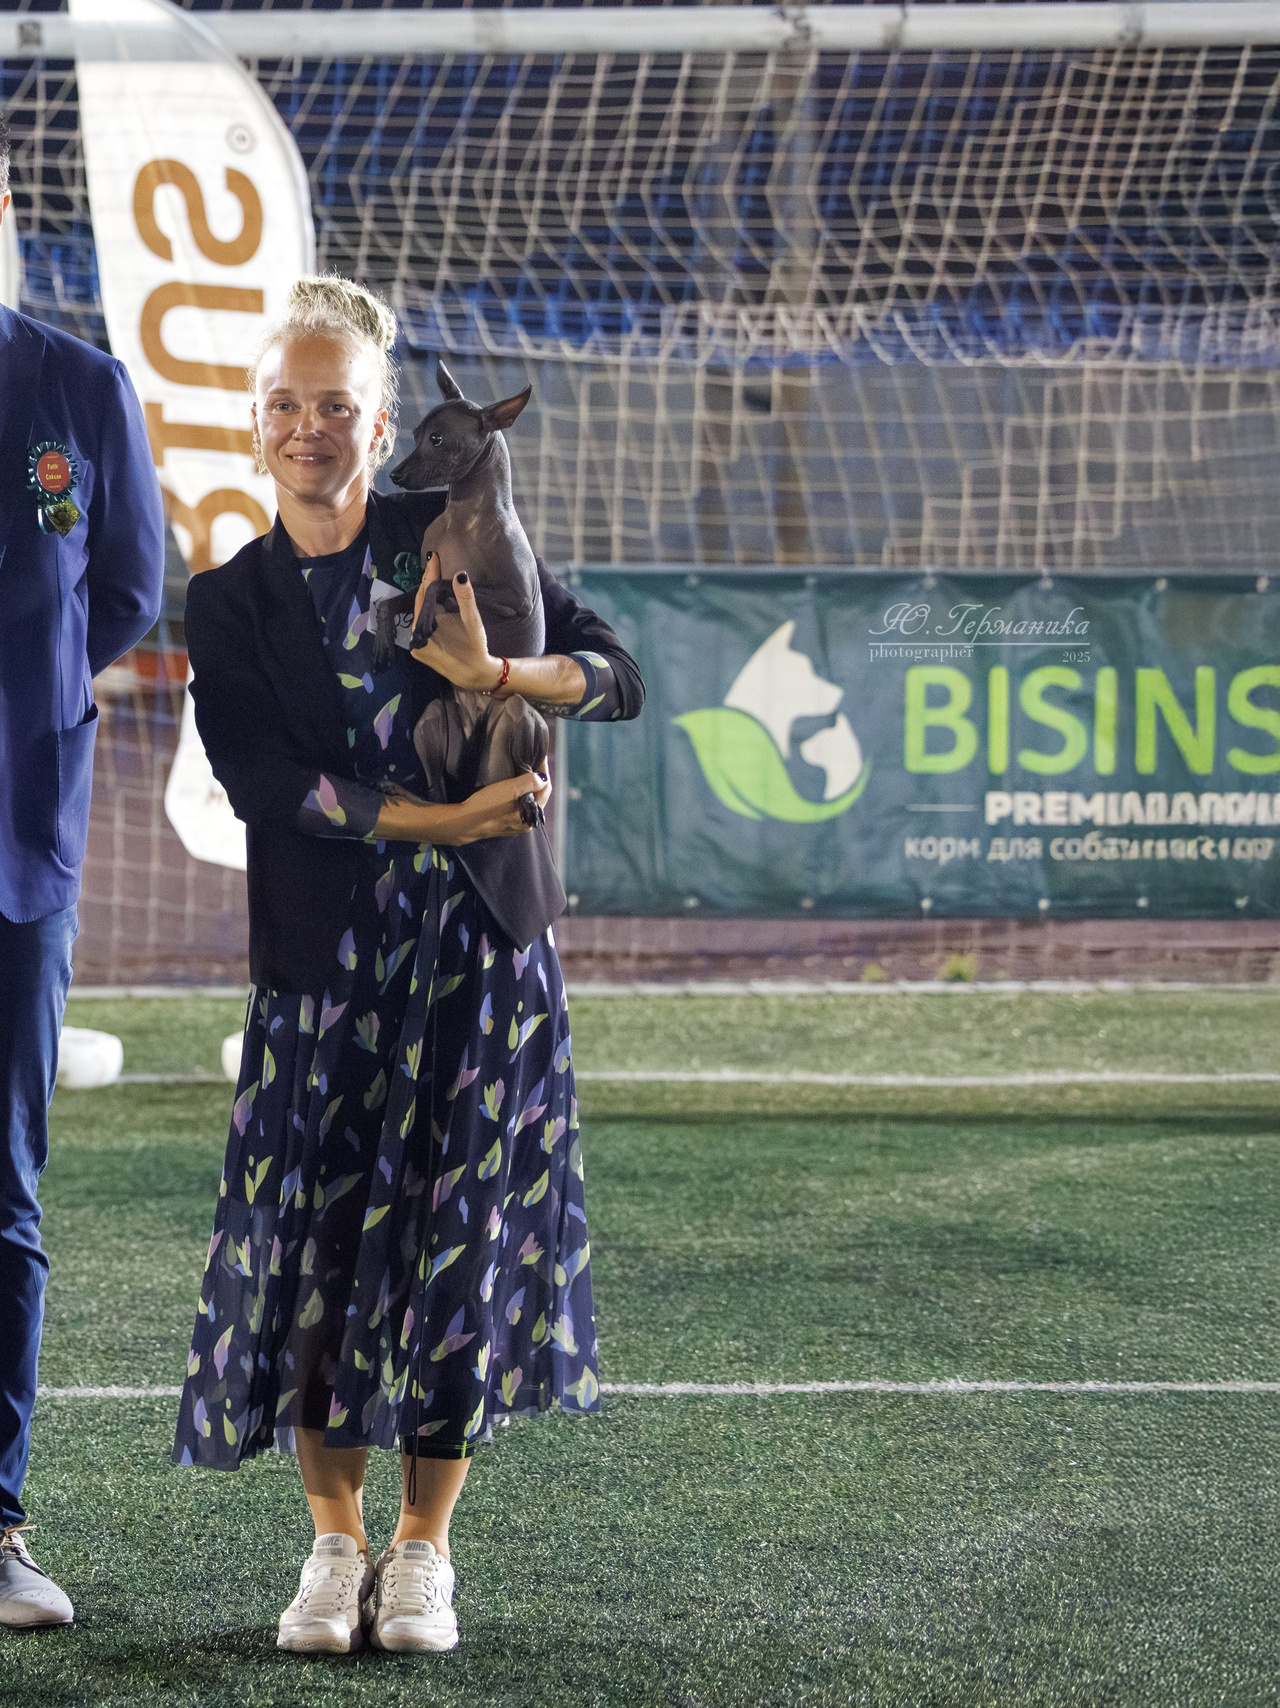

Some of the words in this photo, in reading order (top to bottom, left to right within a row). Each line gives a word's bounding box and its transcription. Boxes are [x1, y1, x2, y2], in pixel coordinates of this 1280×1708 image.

[904, 836, 980, 866] корм
[987, 837, 1044, 862] для
[317, 1535, 342, 1547] NIKE
[404, 1540, 428, 1552] NIKE
